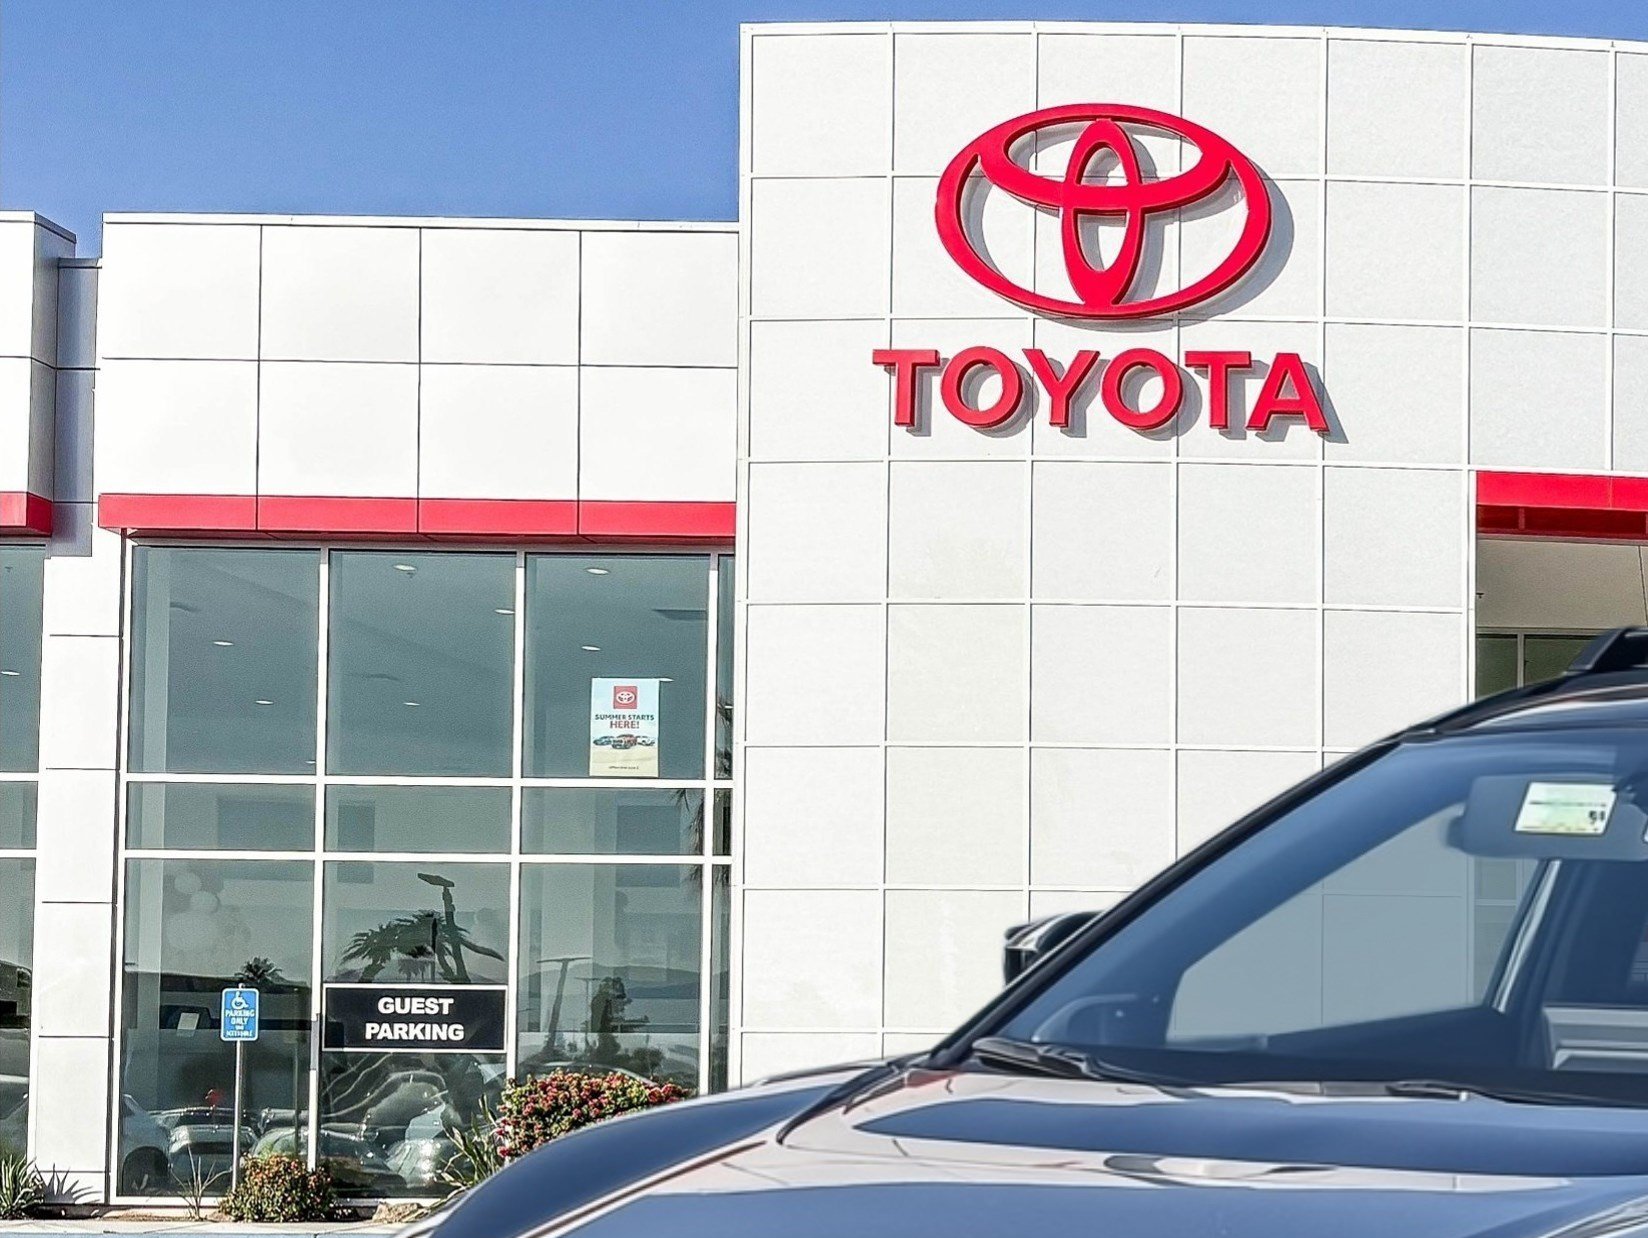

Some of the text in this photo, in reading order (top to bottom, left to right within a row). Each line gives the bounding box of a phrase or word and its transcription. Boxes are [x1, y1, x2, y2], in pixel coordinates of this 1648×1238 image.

[872, 346, 1330, 432] TOYOTA
[609, 720, 640, 729] HERE!
[225, 1009, 255, 1017] PARKING
[377, 997, 454, 1015] GUEST
[365, 1023, 465, 1041] PARKING
